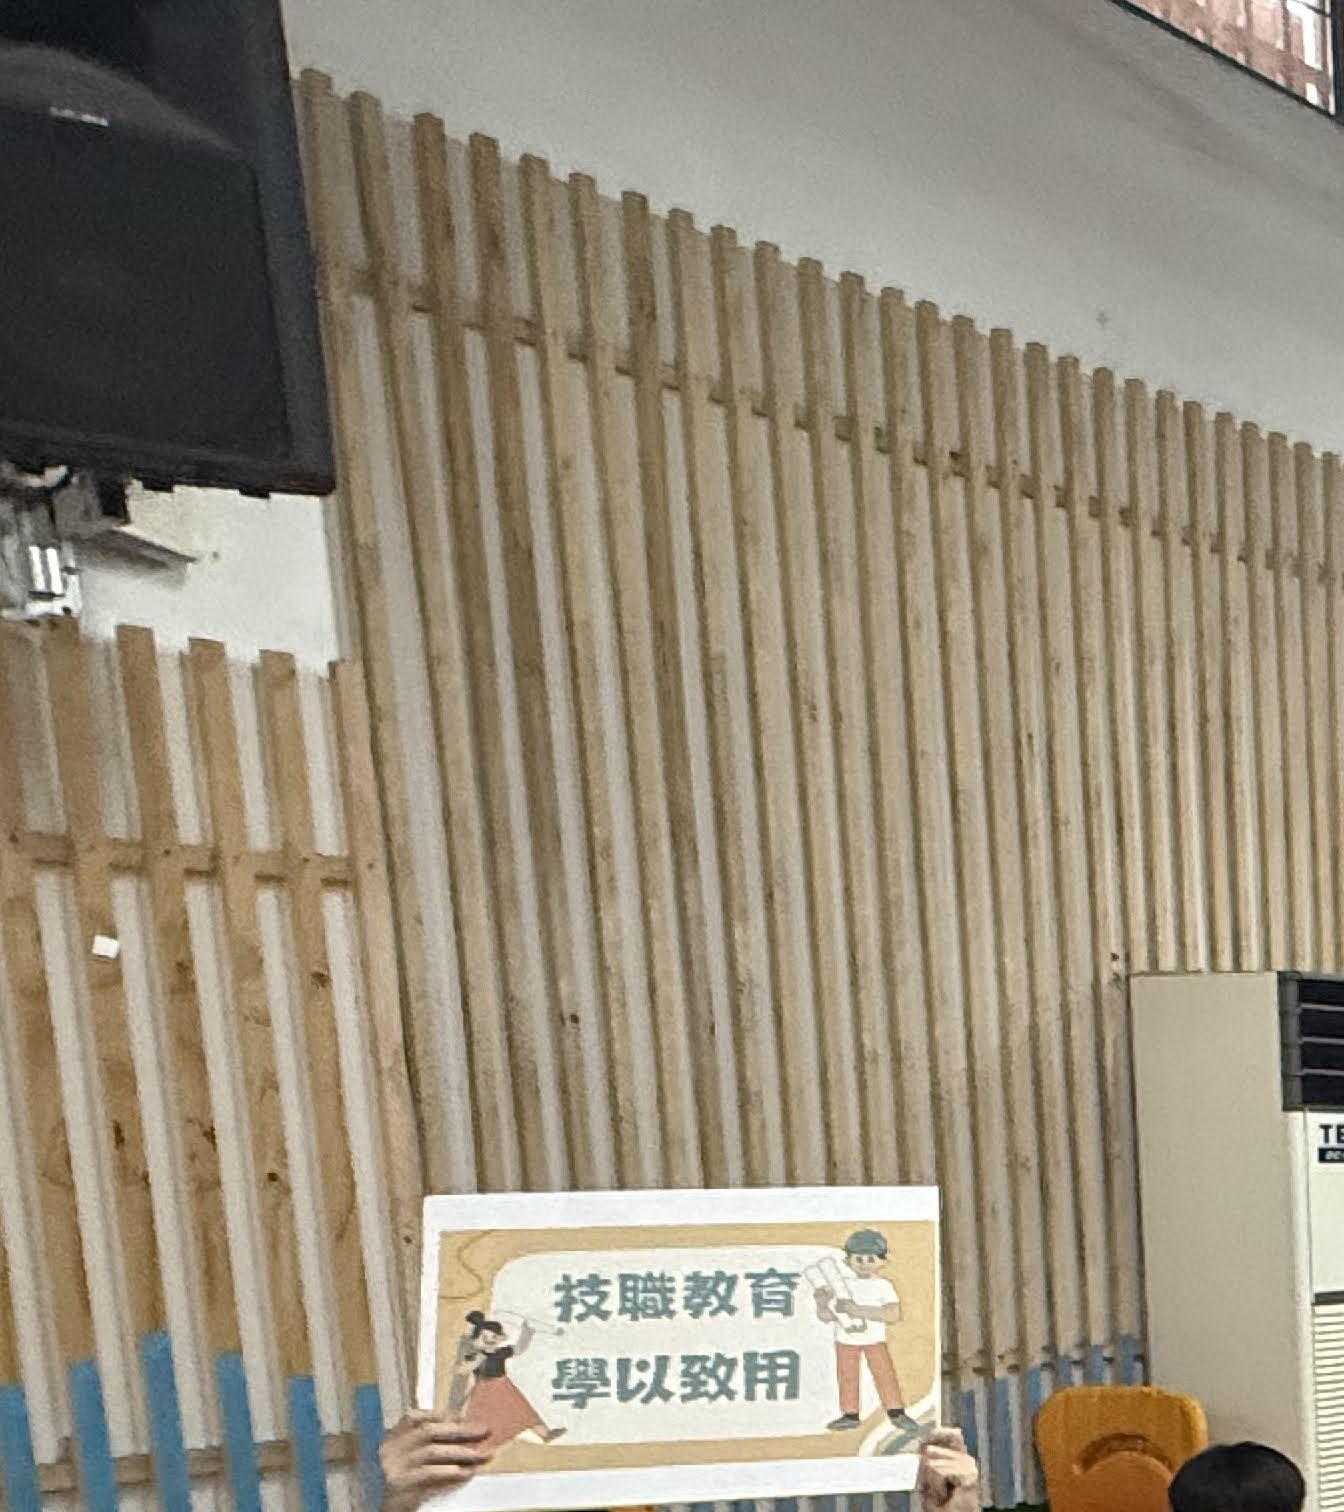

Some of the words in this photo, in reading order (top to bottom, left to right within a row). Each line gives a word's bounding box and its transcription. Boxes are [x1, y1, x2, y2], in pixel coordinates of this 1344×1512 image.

[553, 1267, 801, 1323] 技職教育
[551, 1350, 801, 1409] 學以致用
